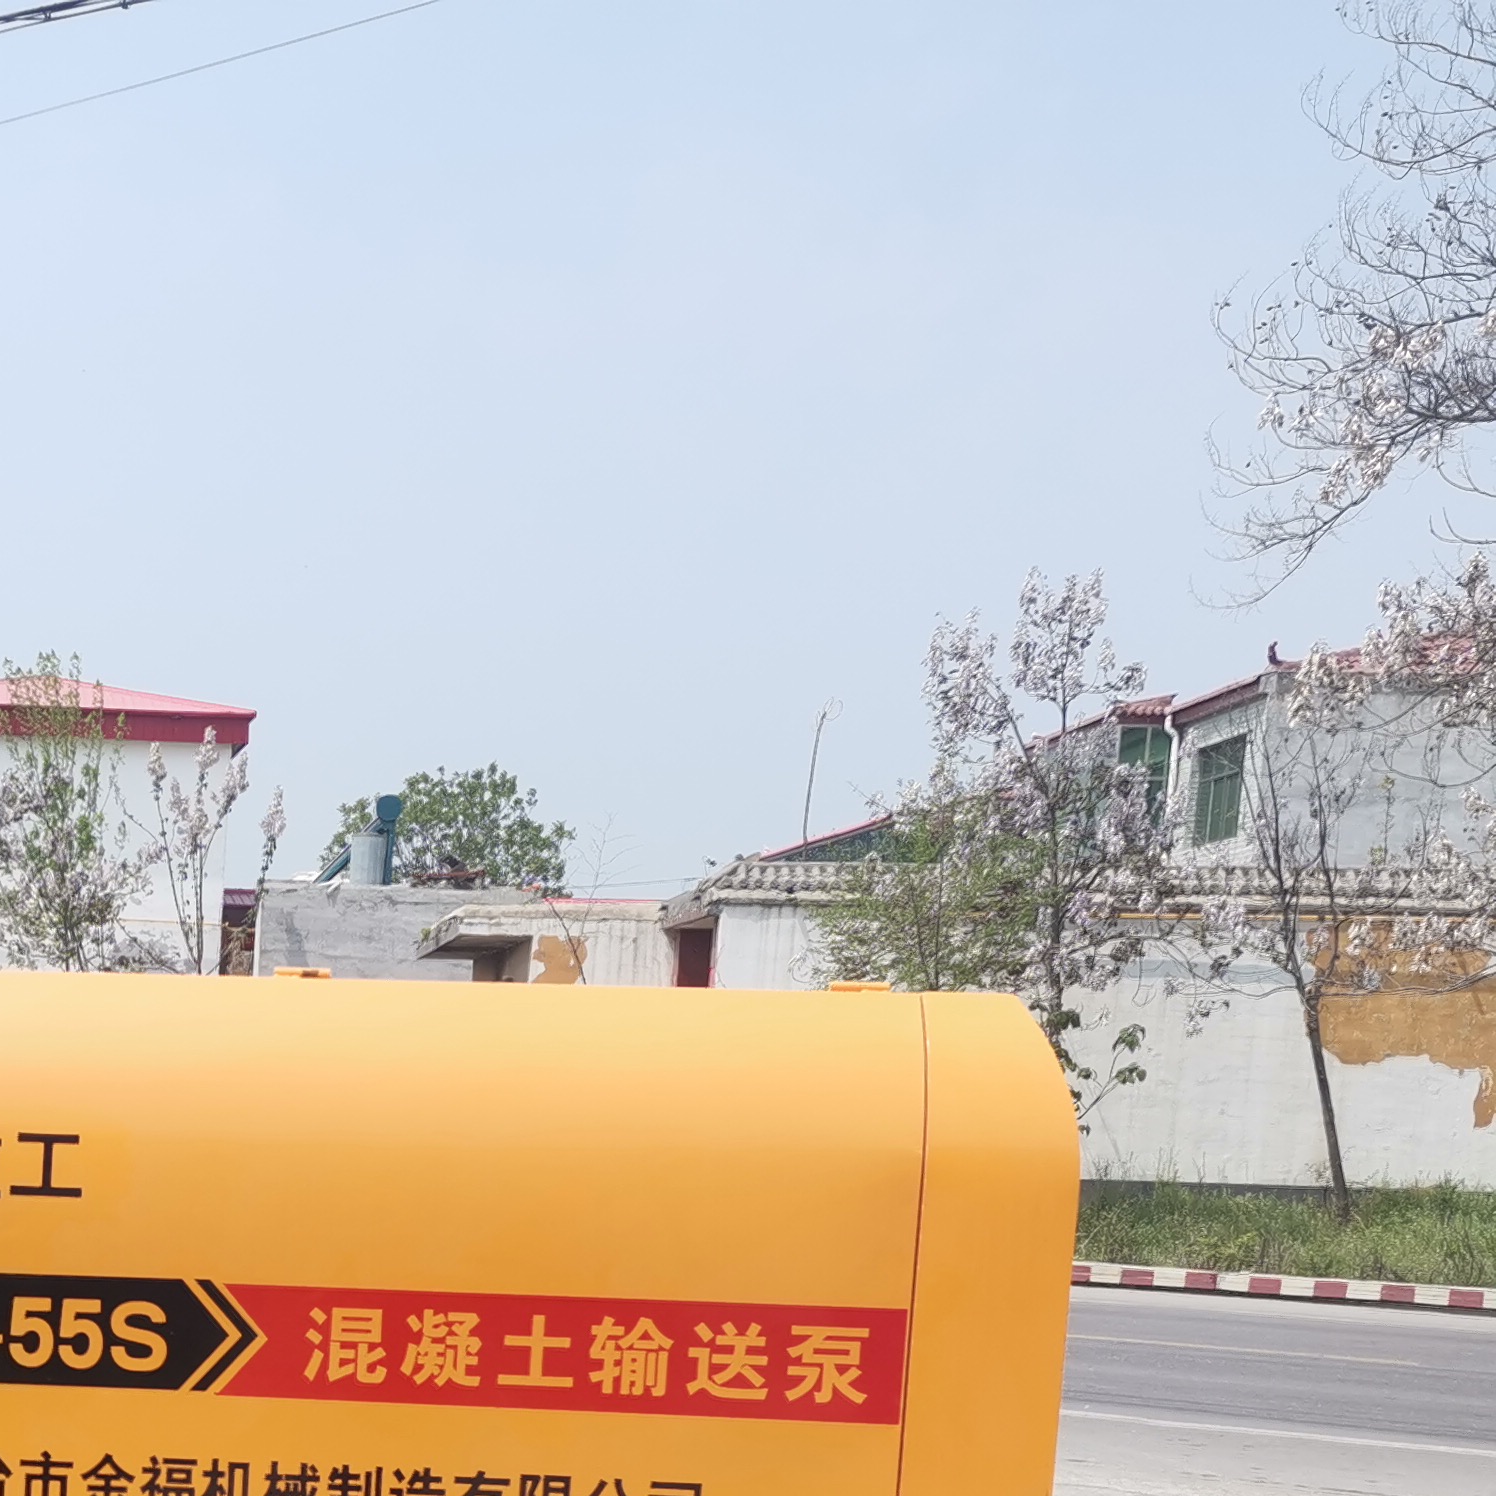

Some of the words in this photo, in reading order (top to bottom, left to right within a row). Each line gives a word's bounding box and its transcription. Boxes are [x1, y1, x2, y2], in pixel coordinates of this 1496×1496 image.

[303, 1306, 872, 1404] 混凝土输送泵
